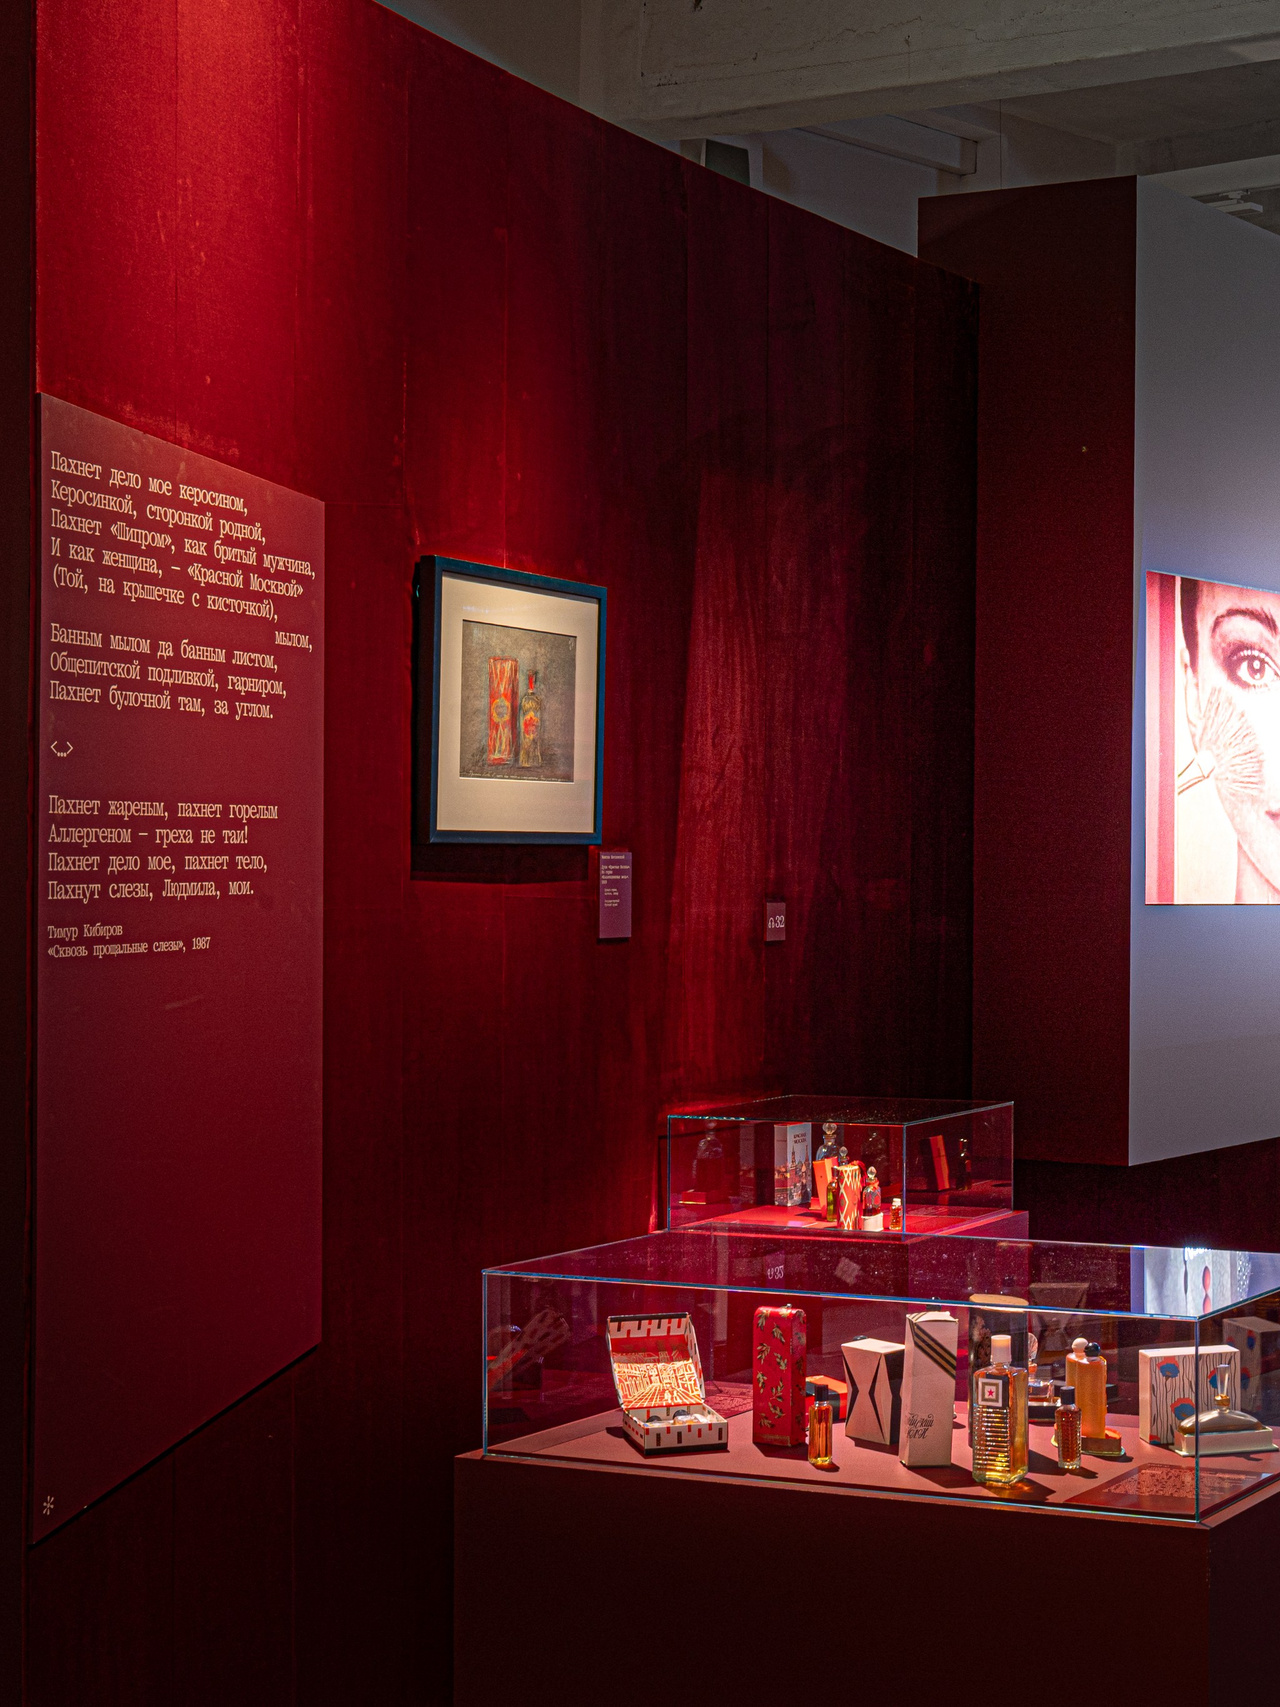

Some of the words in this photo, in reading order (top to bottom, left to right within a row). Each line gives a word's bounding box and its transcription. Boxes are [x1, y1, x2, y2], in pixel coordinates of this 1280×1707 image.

[51, 450, 103, 479] Пахнет
[109, 468, 142, 489] дело
[149, 476, 173, 495] мое
[179, 483, 248, 516] керосином,
[51, 479, 138, 519] Керосинкой,
[147, 504, 214, 531] сторонкой
[219, 520, 266, 545] родной,
[51, 508, 103, 535] Пахнет
[110, 522, 176, 554] «Шипром»,
[184, 536, 208, 556] как
[214, 540, 258, 565] бритый
[263, 553, 316, 580] мужчина,
[51, 537, 61, 556] И
[69, 543, 96, 562] как
[102, 550, 163, 578] женщина,
[188, 563, 244, 588] «Красной
[250, 573, 304, 597] Москвой»
[53, 563, 89, 594] (Той,
[98, 576, 116, 594] на
[123, 580, 185, 604] крышечке
[192, 591, 201, 607] с
[207, 595, 278, 623] кисточкой),
[51, 623, 103, 647] Банным
[110, 633, 151, 653] мылом
[157, 640, 175, 660] да
[181, 639, 227, 663] банным
[232, 649, 278, 673] листом,
[275, 630, 313, 652] мылом,
[50, 652, 141, 679] Общепитской
[148, 664, 219, 692] подливкой,
[228, 675, 287, 699] гарниром,
[50, 680, 102, 703] Пахнет
[109, 684, 172, 710] булочной
[178, 696, 206, 717] там,
[214, 699, 230, 715] за
[235, 699, 274, 720] углом.
[49, 795, 101, 814] Пахнет
[108, 800, 169, 820] жареным,
[178, 802, 223, 817] пахнет
[229, 804, 279, 822] горелым
[48, 823, 132, 847] Аллергеном
[155, 827, 194, 848] греха
[200, 829, 216, 843] не
[222, 825, 249, 844] таи!
[48, 852, 101, 871] Пахнет
[108, 853, 141, 875] дело
[148, 854, 176, 874] мое,
[185, 854, 230, 870] пахнет
[236, 854, 268, 873] тело,
[48, 880, 102, 904] Пахнут
[109, 881, 154, 901] слезы,
[162, 878, 221, 900] Людмила,
[229, 879, 255, 895] мои.
[48, 924, 79, 941] Тимур
[84, 921, 124, 939] Кибиров
[775, 915, 785, 928] 32
[48, 944, 89, 958] «Сквозь
[93, 940, 149, 958] прощальные
[153, 938, 186, 953] слезы»,
[192, 936, 212, 949] 1987
